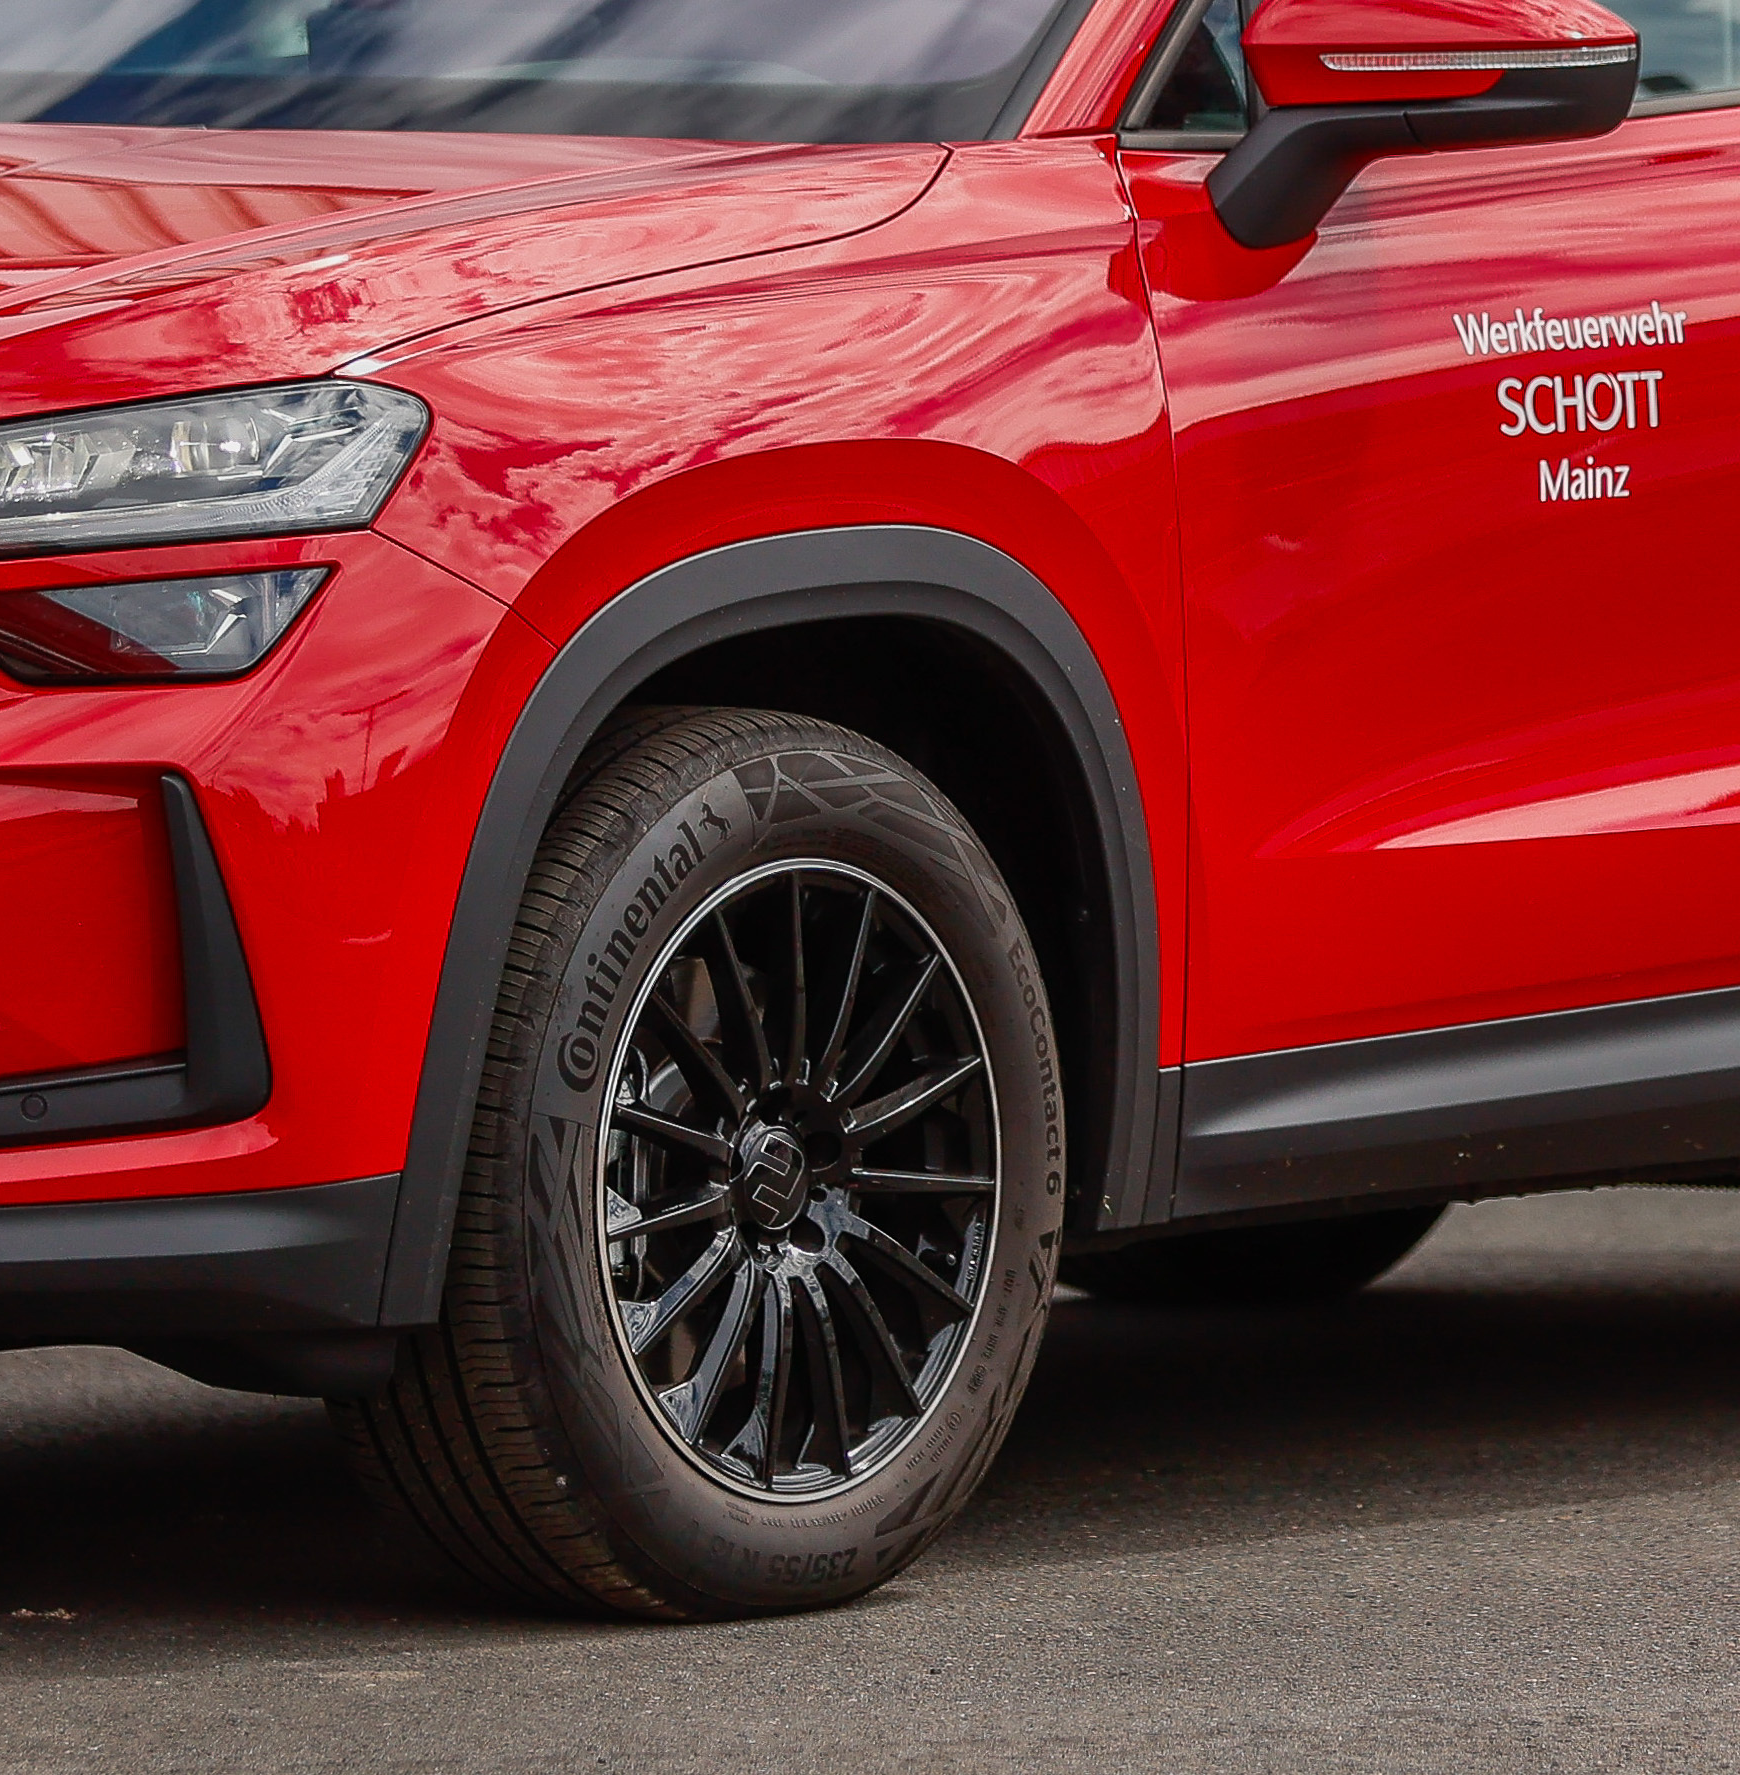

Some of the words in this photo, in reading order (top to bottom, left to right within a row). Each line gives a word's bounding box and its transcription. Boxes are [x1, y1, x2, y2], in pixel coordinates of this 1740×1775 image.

[1452, 301, 1687, 355] Werkfeuerwehr
[1496, 370, 1664, 436] SCHOTT
[1538, 456, 1630, 502] Mainz
[558, 820, 706, 1092] Continental
[1008, 936, 1061, 1162] EcoContact
[1046, 1170, 1061, 1196] 6
